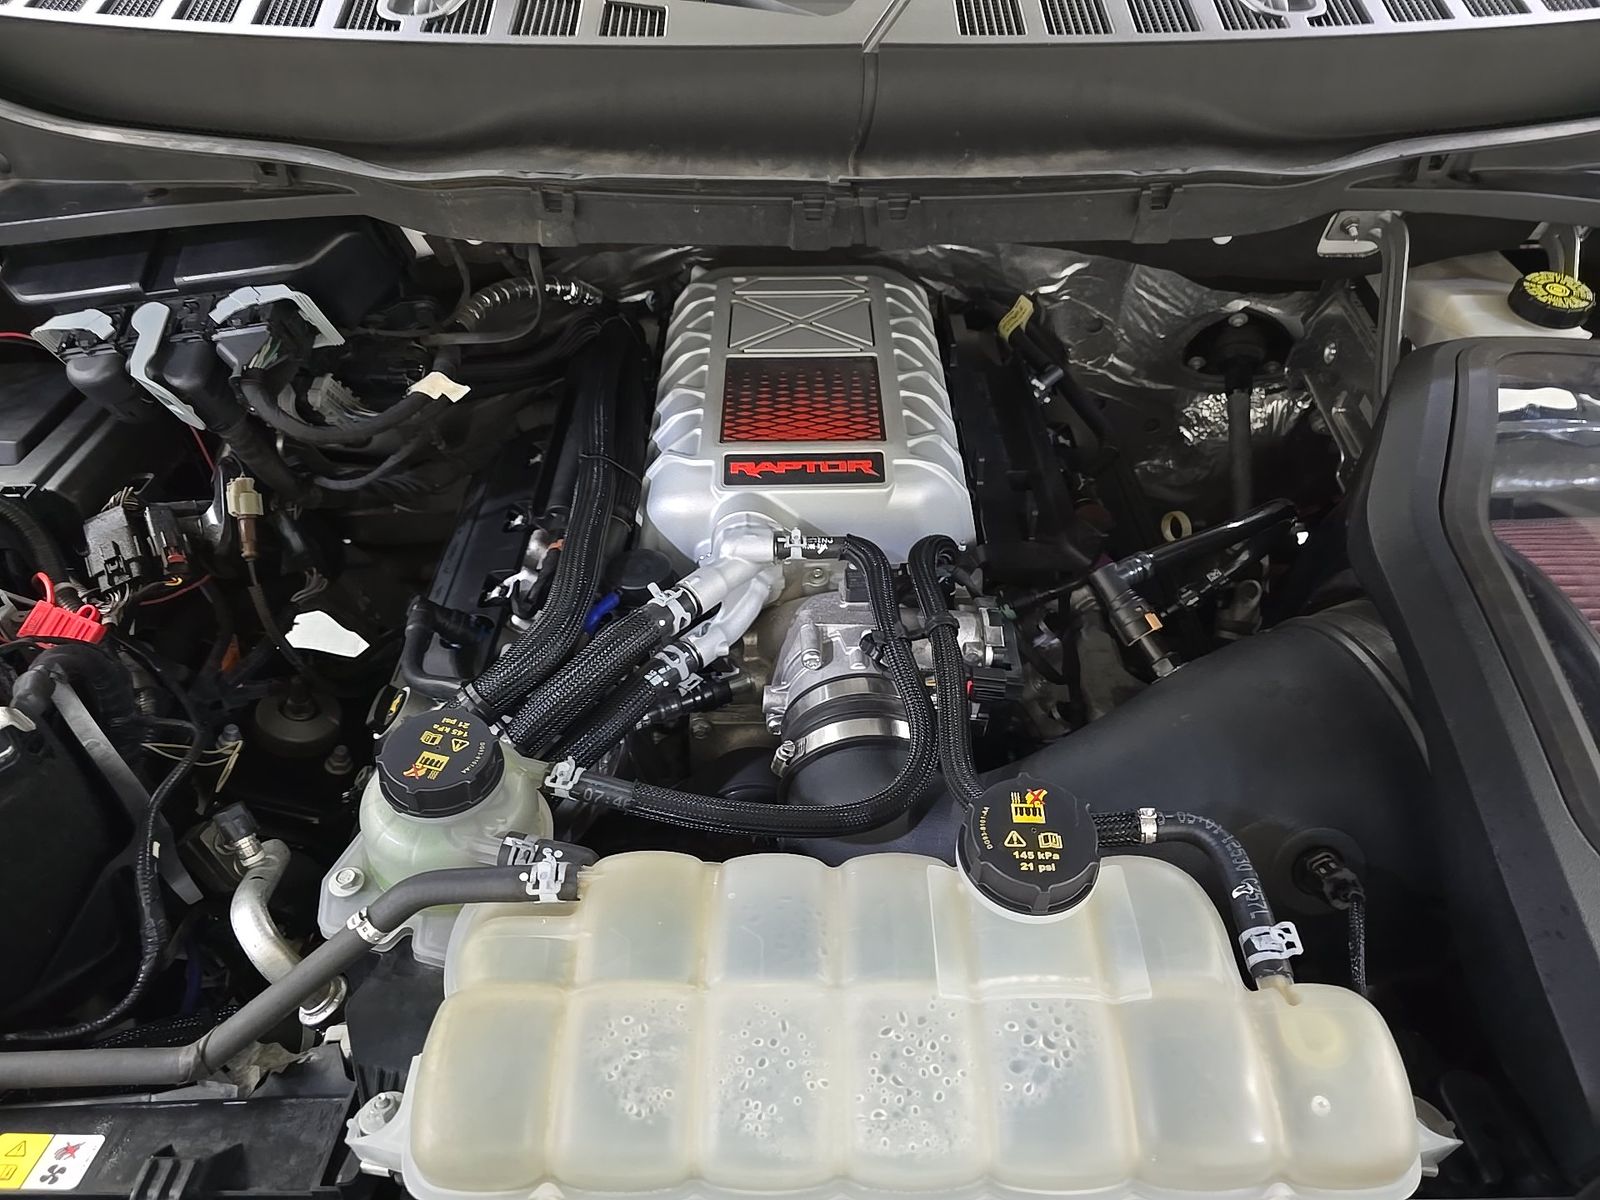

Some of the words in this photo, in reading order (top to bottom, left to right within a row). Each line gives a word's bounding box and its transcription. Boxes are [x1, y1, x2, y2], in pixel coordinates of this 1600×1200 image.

[729, 459, 880, 479] RAPTOR
[1012, 850, 1035, 860] 145
[1037, 851, 1060, 860] kPa
[1020, 862, 1034, 871] 21
[1038, 863, 1056, 873] psi
